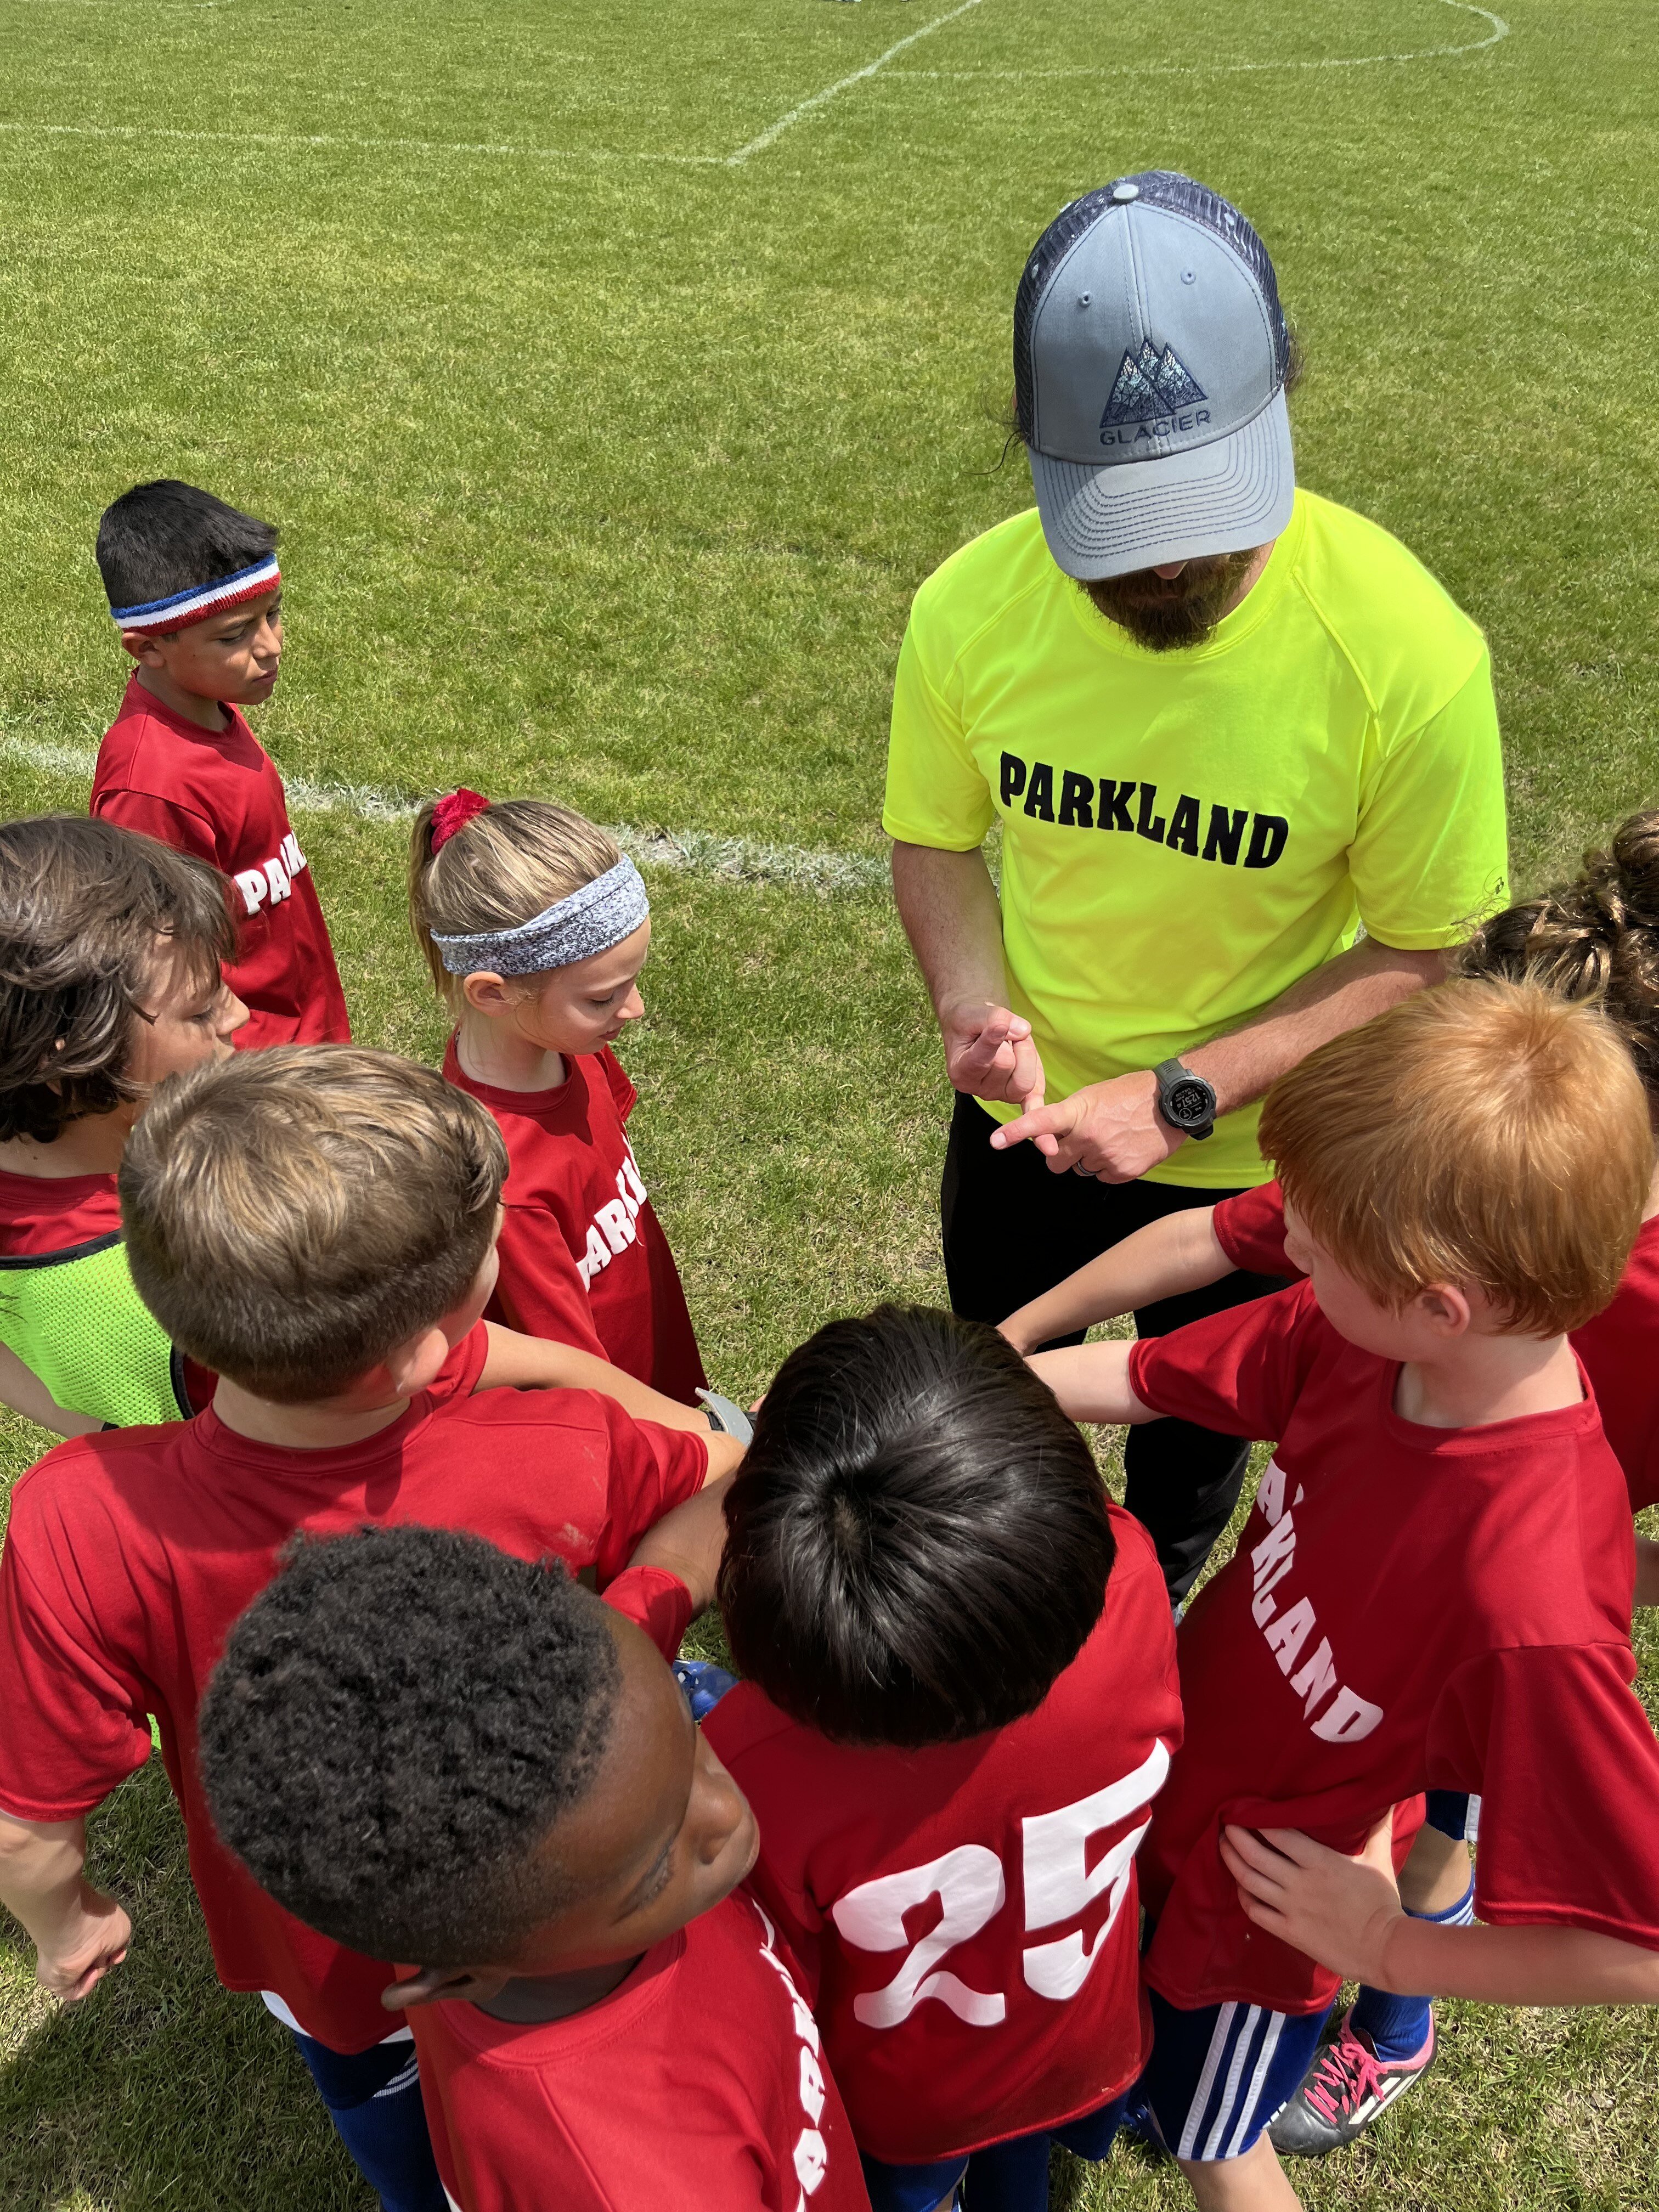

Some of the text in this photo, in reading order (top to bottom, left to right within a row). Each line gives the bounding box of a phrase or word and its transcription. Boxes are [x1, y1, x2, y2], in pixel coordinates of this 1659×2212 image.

[1100, 410, 1211, 445] GLACIER
[1000, 750, 1289, 869] PARKLAND
[832, 1736, 1170, 2029] 25
